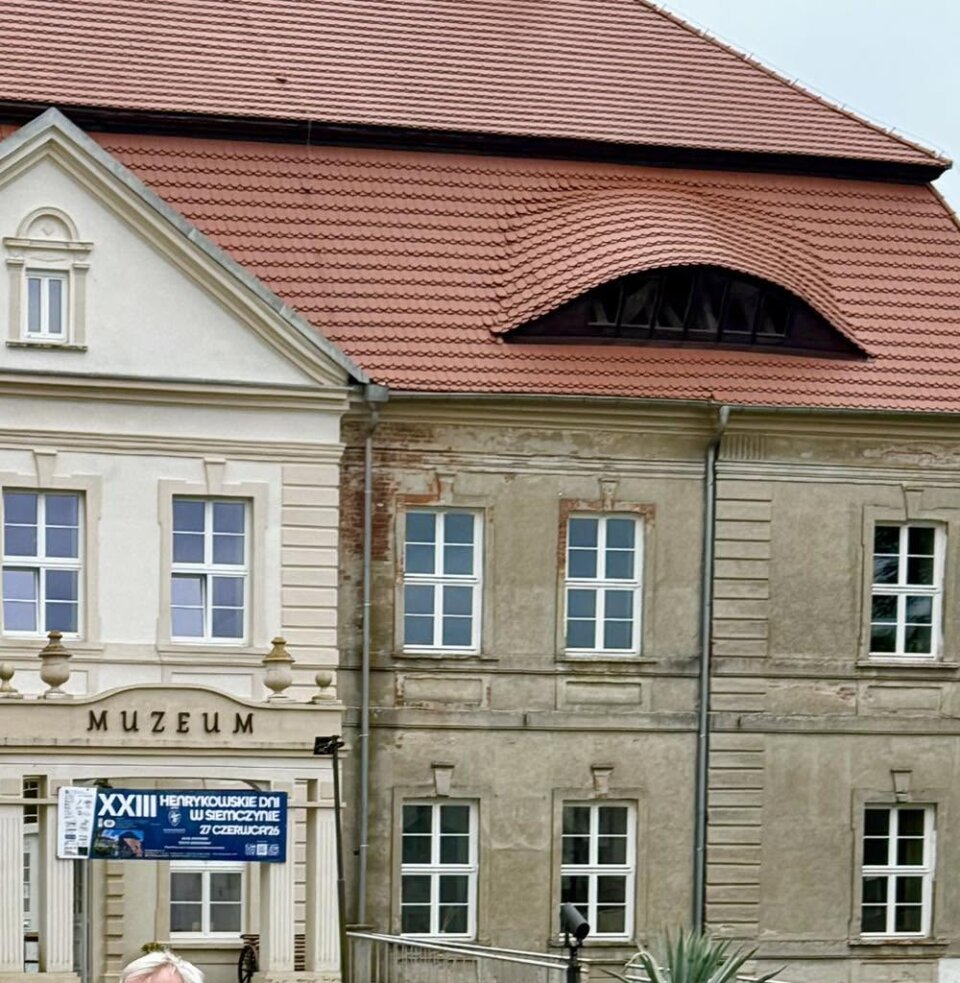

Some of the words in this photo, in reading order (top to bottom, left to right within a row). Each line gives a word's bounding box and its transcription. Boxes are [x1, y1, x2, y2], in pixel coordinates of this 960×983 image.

[87, 710, 254, 734] MUZEUM
[97, 793, 157, 818] XXIII
[159, 795, 257, 808] HENRYKOWSKIE
[189, 809, 204, 821] W
[205, 810, 280, 822] SIEMCZYNIE
[199, 825, 211, 835] 27
